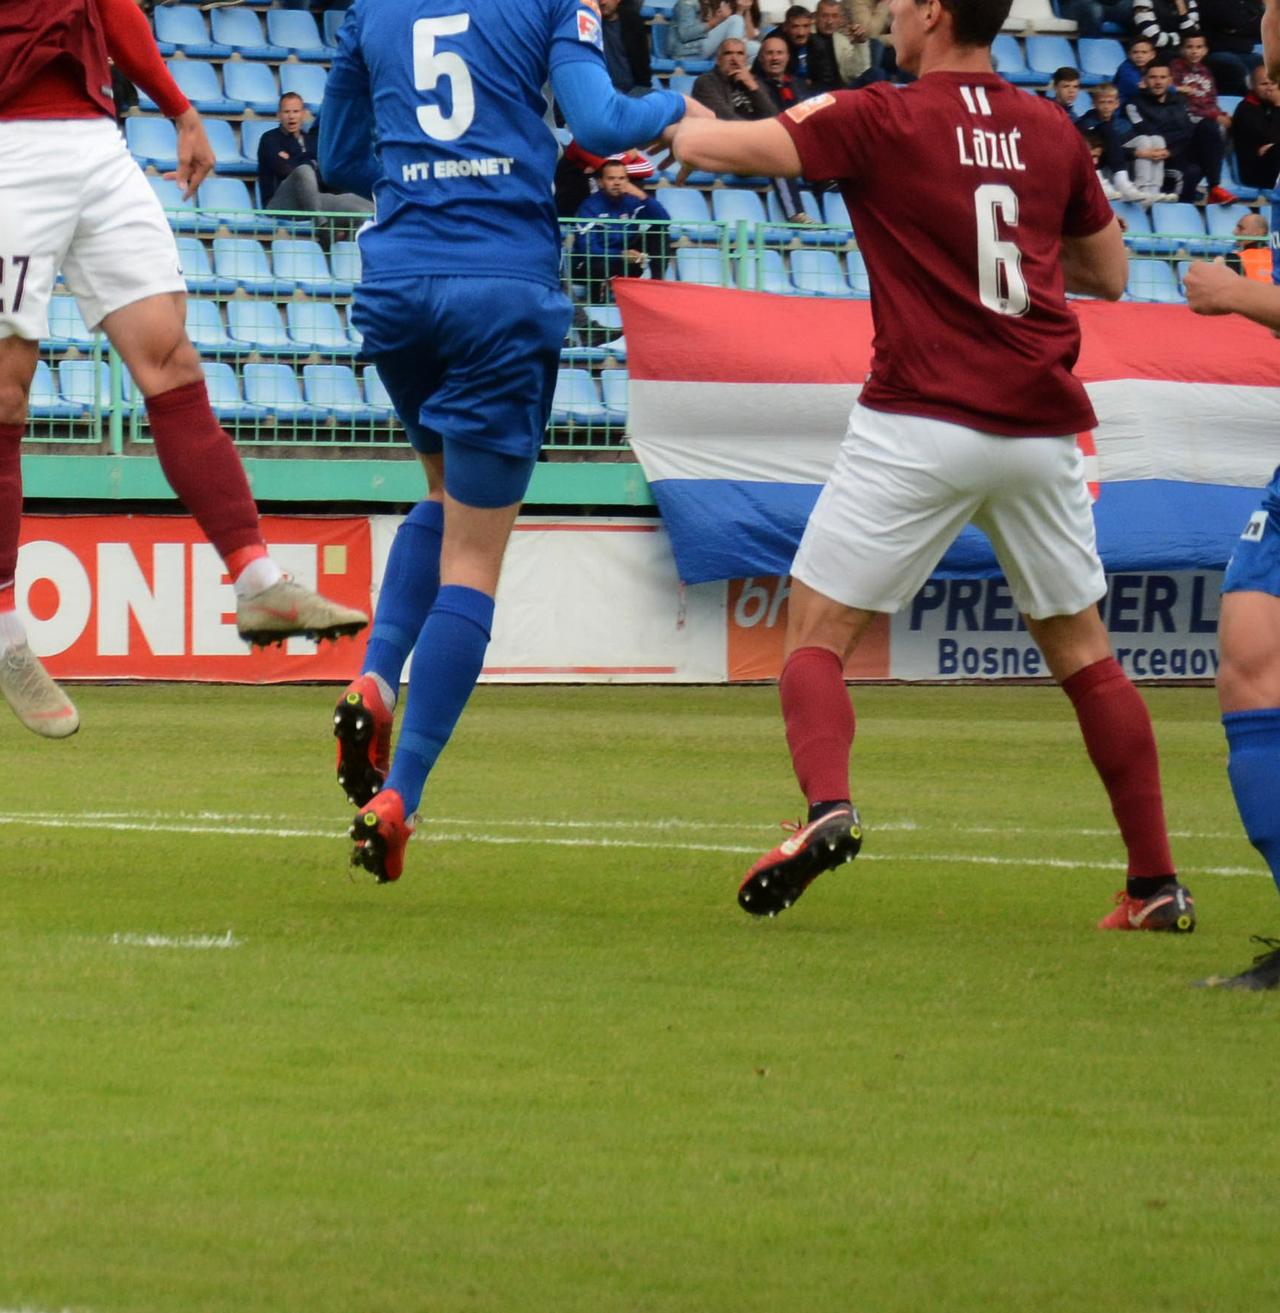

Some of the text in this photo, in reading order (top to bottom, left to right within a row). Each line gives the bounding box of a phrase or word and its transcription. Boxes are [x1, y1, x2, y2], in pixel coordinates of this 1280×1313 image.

[411, 13, 476, 142] 5
[402, 157, 515, 182] HT ERONET
[974, 183, 1030, 318] 6
[938, 637, 1041, 675] Bosne
